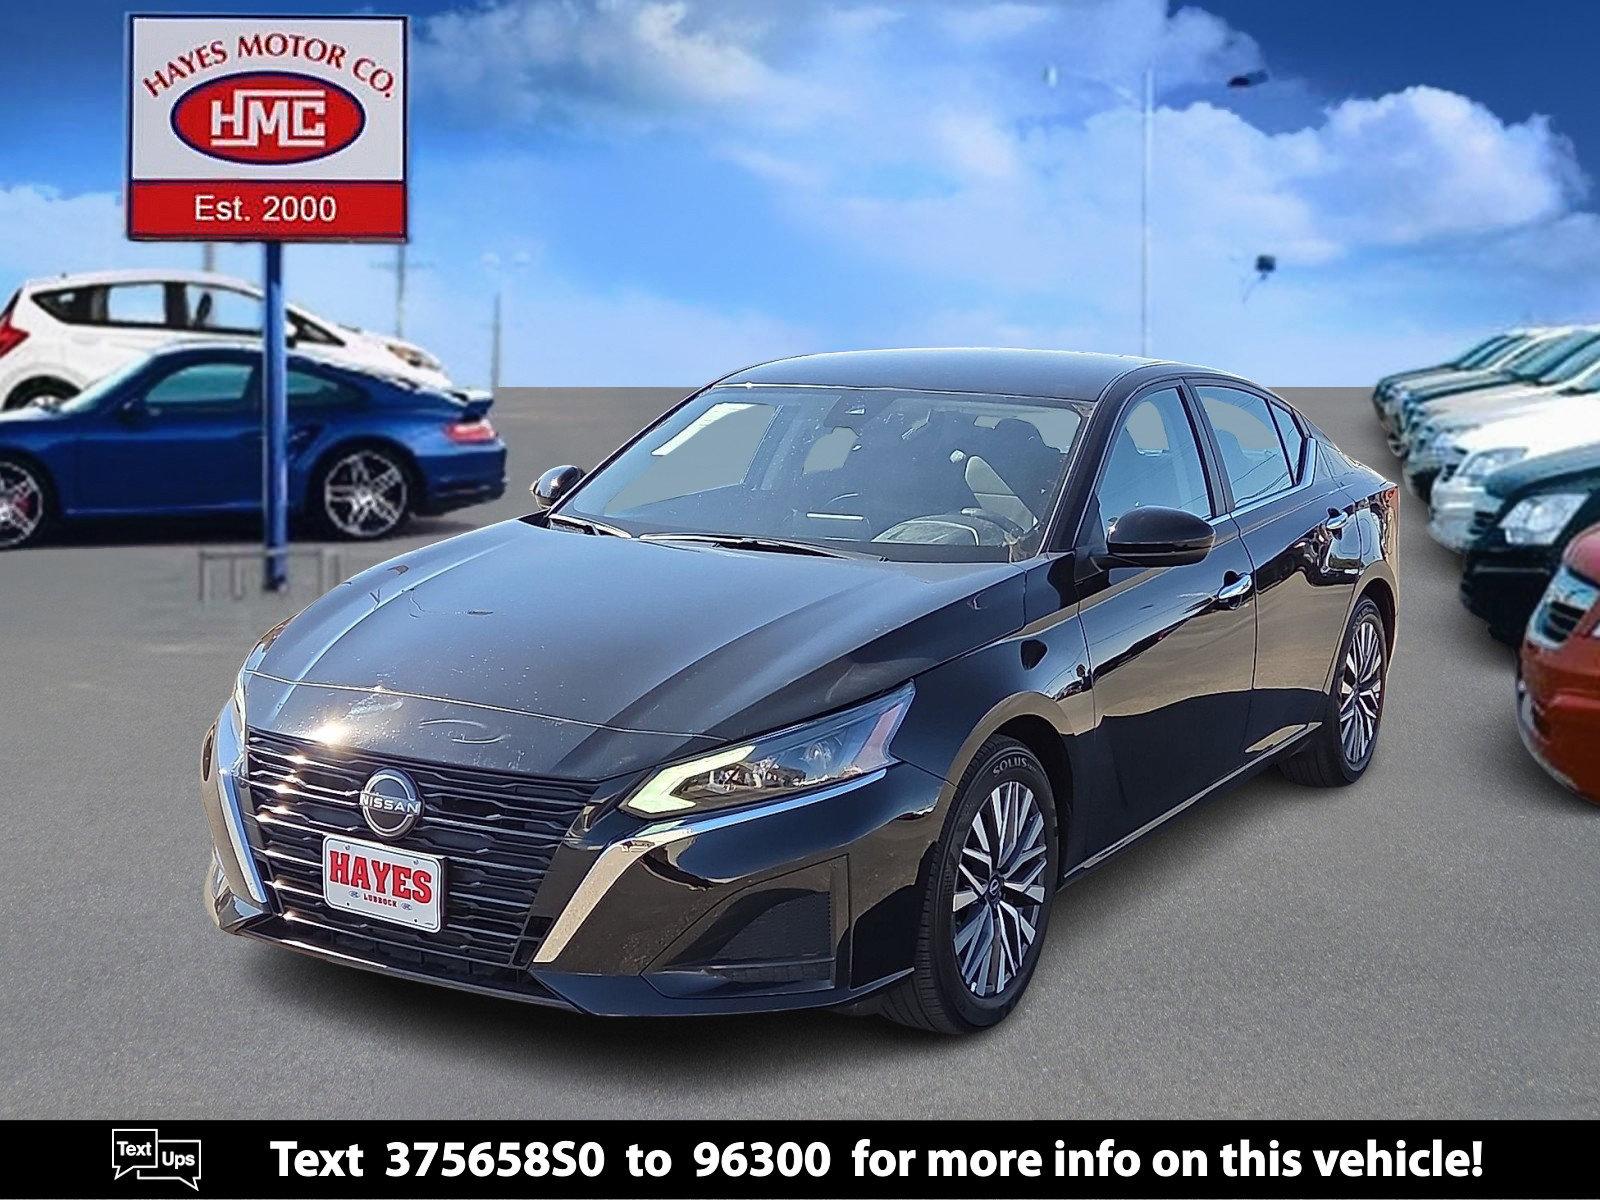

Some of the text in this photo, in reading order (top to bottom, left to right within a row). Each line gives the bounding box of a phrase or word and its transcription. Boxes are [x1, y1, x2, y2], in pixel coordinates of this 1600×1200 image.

[143, 33, 394, 99] HAYES MOTOR CO.
[210, 89, 326, 147] HMC
[195, 195, 337, 222] Est. 2000
[993, 757, 1028, 778] SOLUS
[359, 793, 421, 815] NISSAN
[330, 851, 432, 904] HAYES
